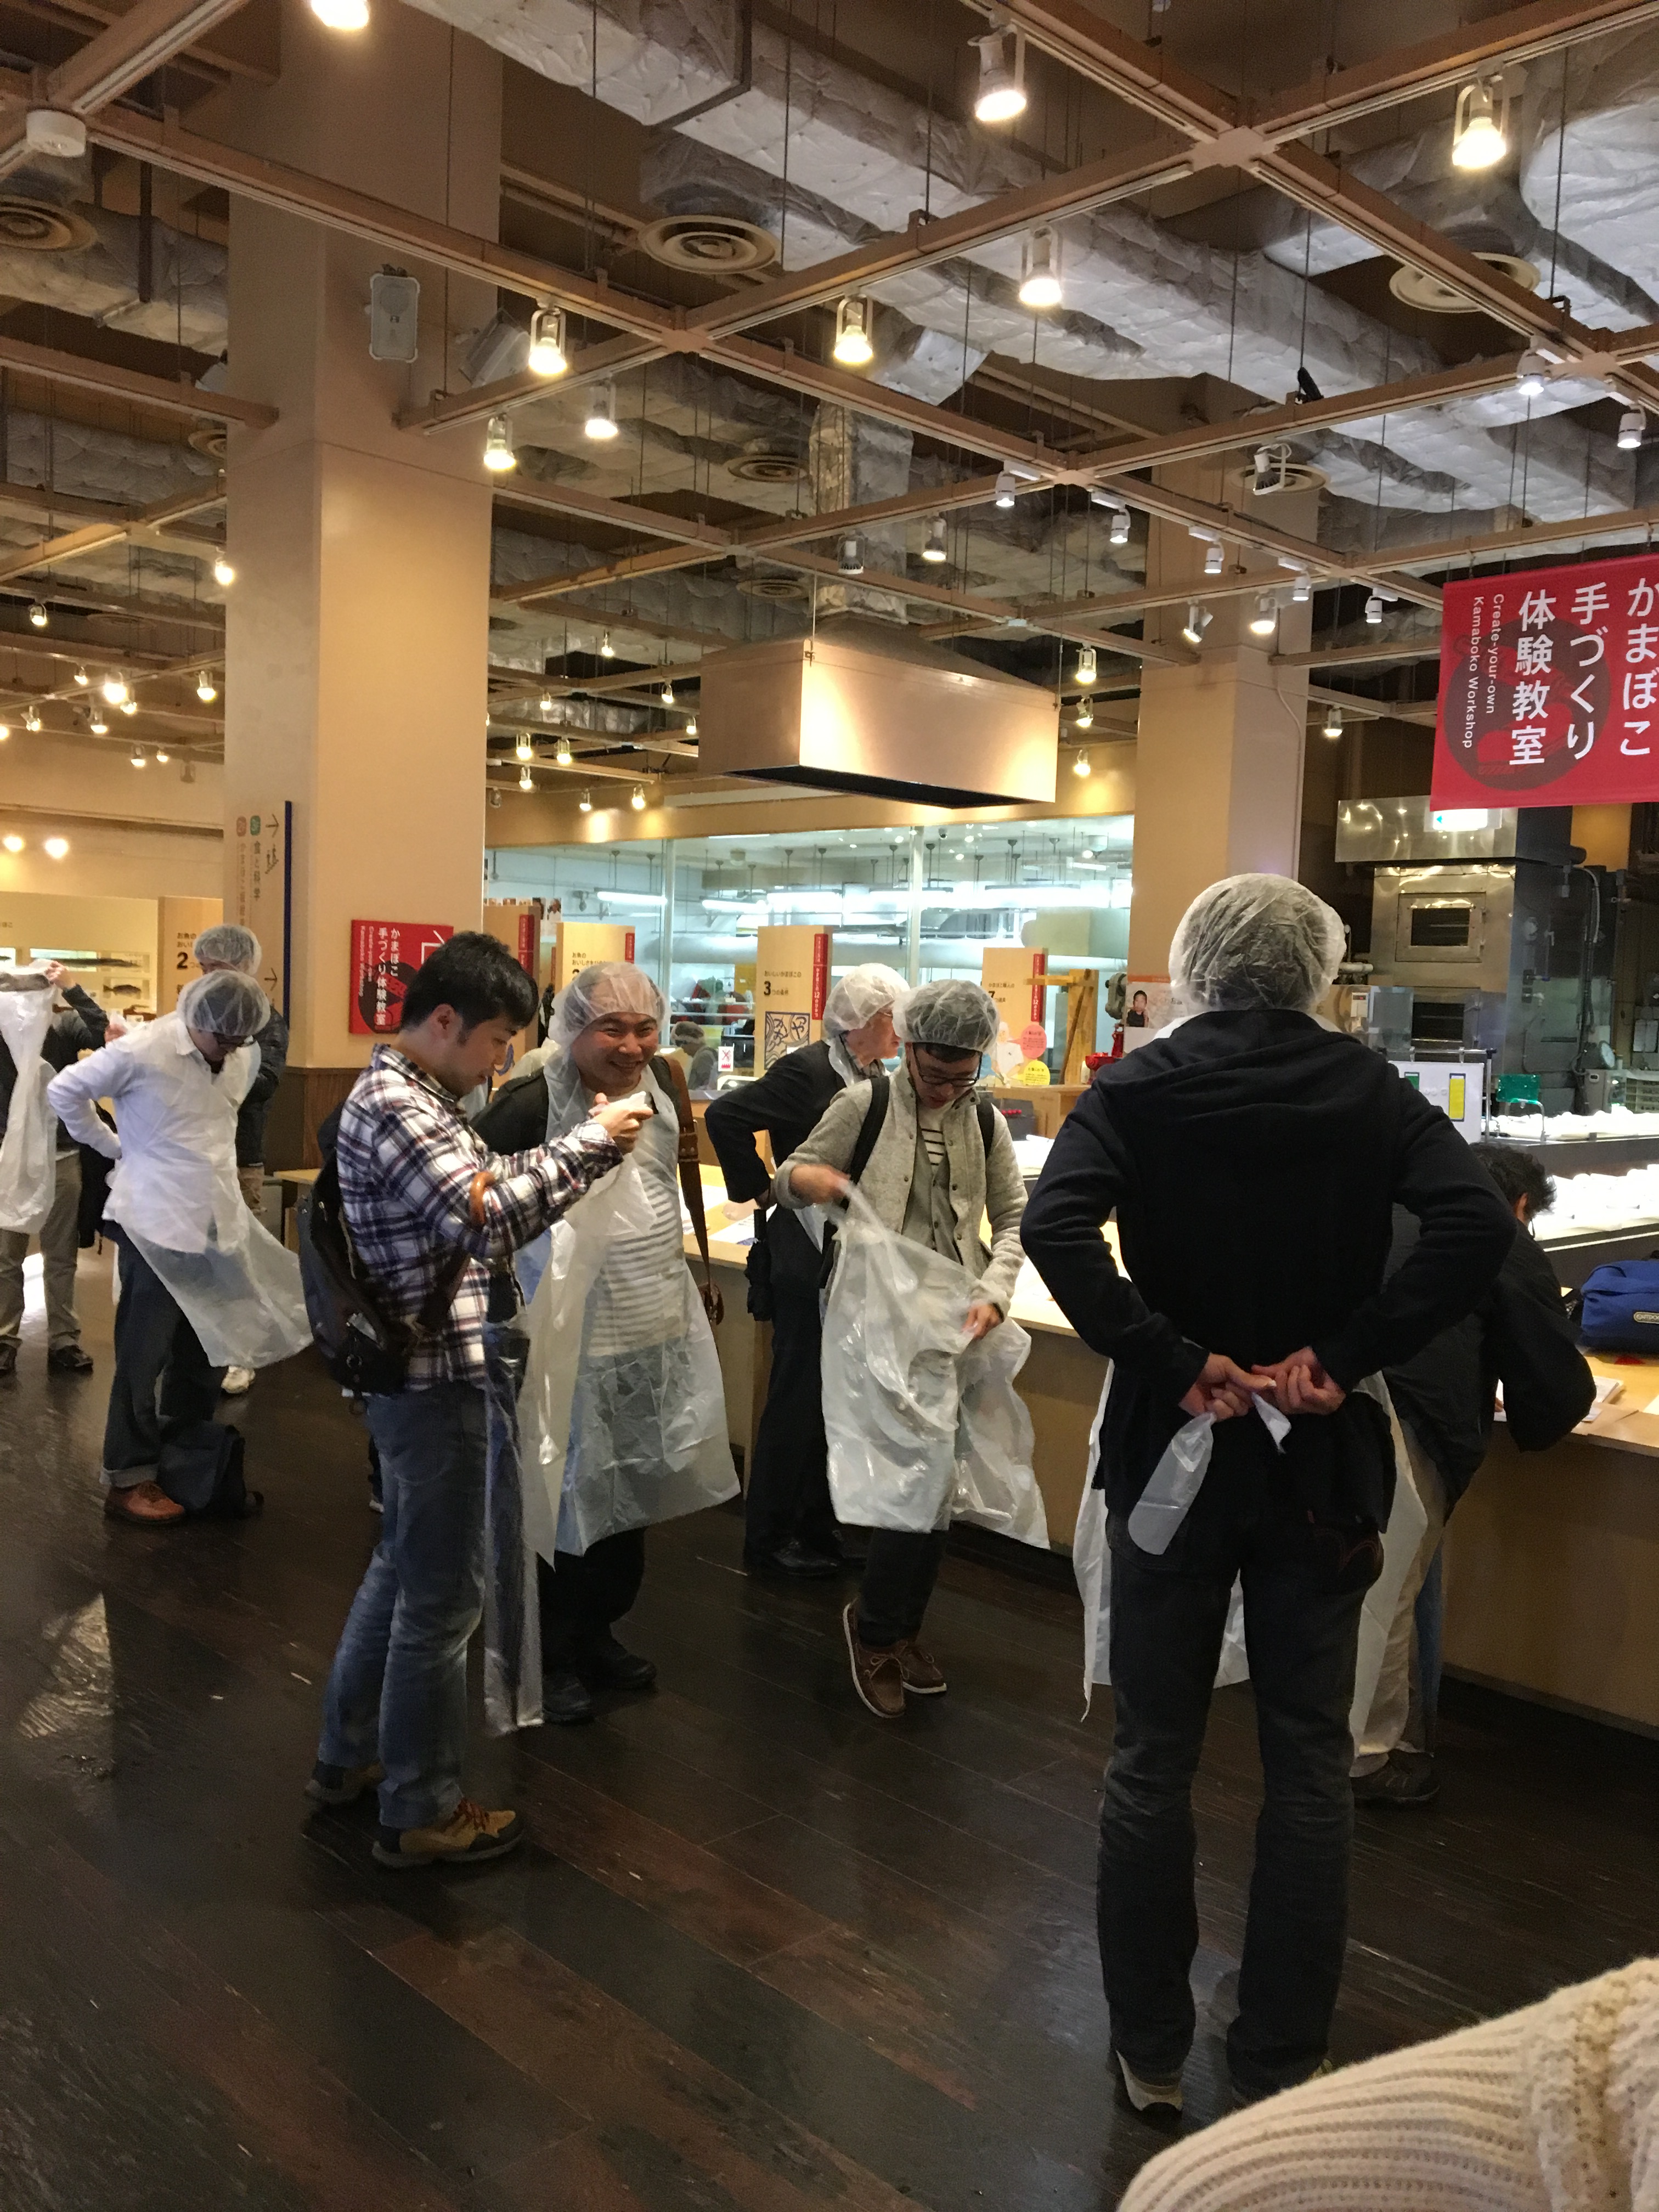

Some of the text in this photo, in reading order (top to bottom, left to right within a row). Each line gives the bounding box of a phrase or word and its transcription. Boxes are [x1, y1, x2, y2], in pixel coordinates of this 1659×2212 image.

[1462, 596, 1485, 748] Kamaboko Workshop
[1486, 593, 1504, 714] Create-your-own
[1509, 589, 1557, 766] 体験教室
[1567, 582, 1610, 760] 手づくり
[1620, 578, 1659, 755] かまぼこ
